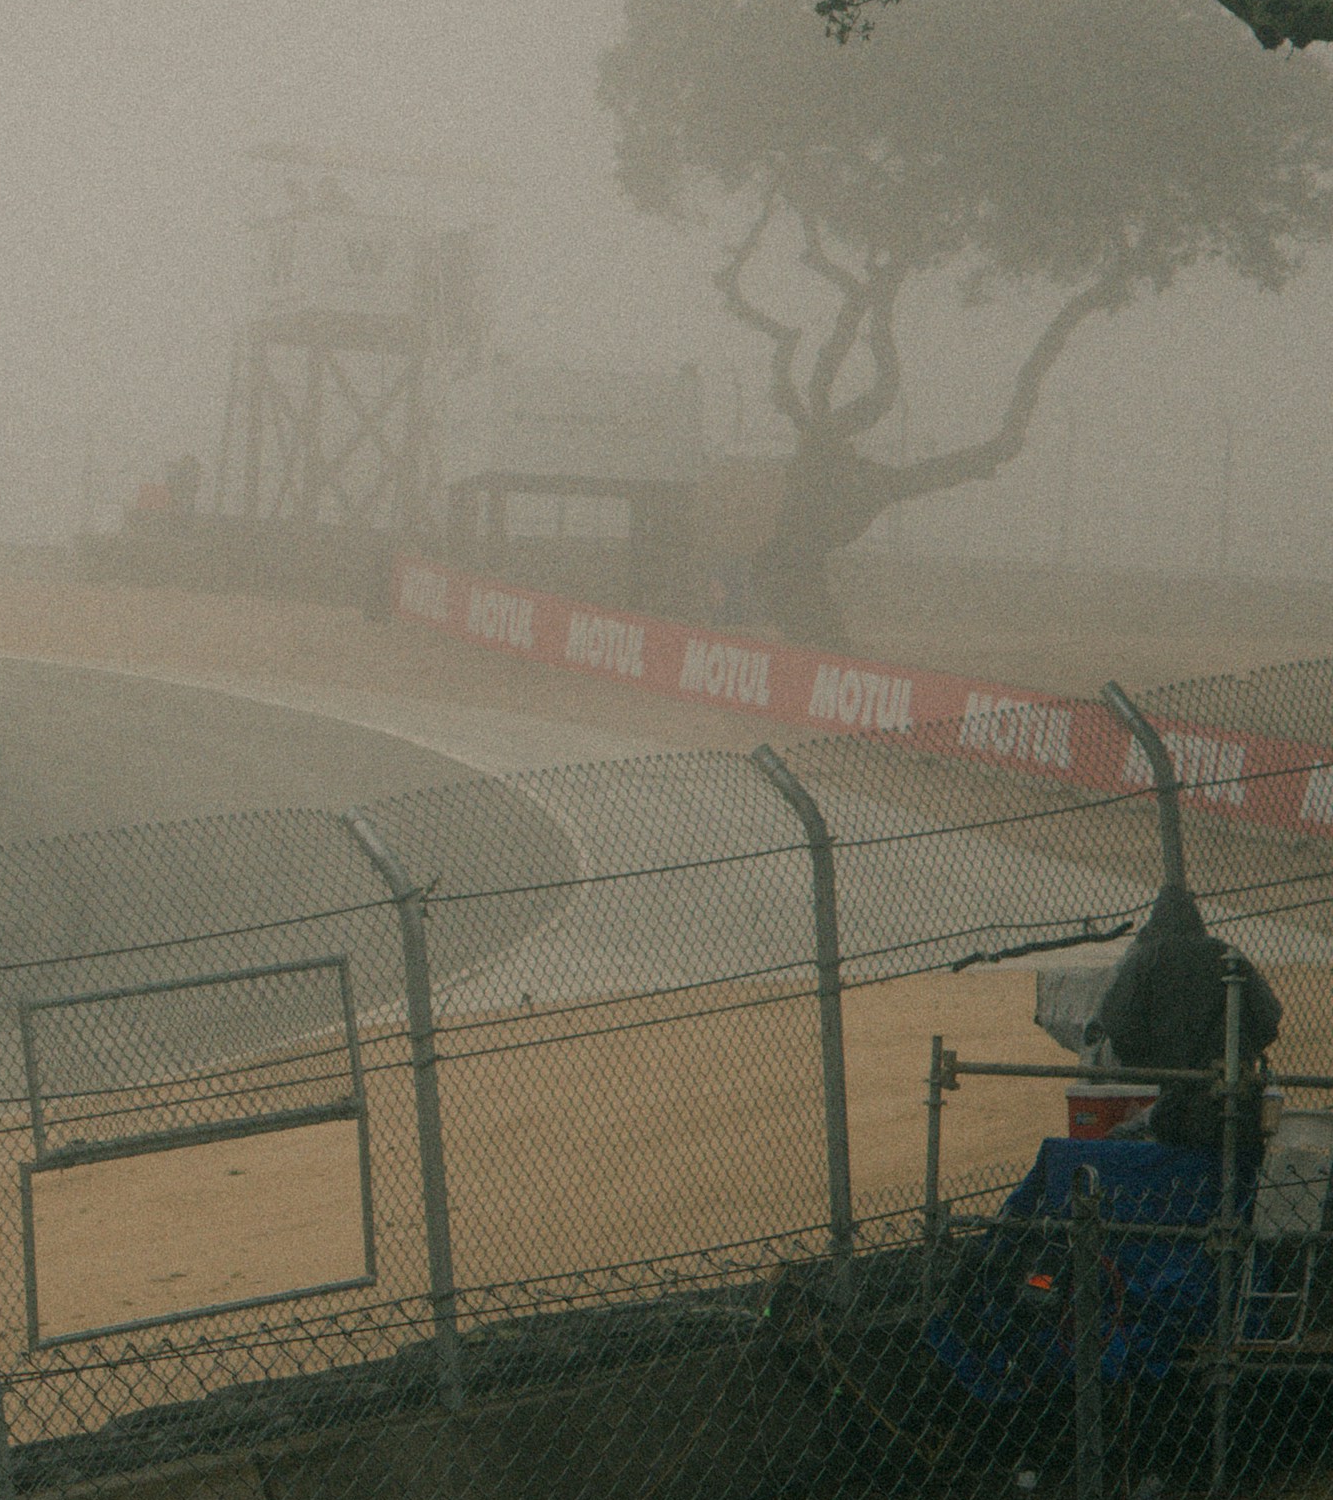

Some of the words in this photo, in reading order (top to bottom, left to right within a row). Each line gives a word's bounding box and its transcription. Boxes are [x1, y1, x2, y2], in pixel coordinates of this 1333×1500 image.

[565, 610, 645, 677] MOTUL
[679, 637, 771, 706] MOTUL
[809, 663, 913, 734] MOTUL
[959, 691, 1072, 769] MOTUL
